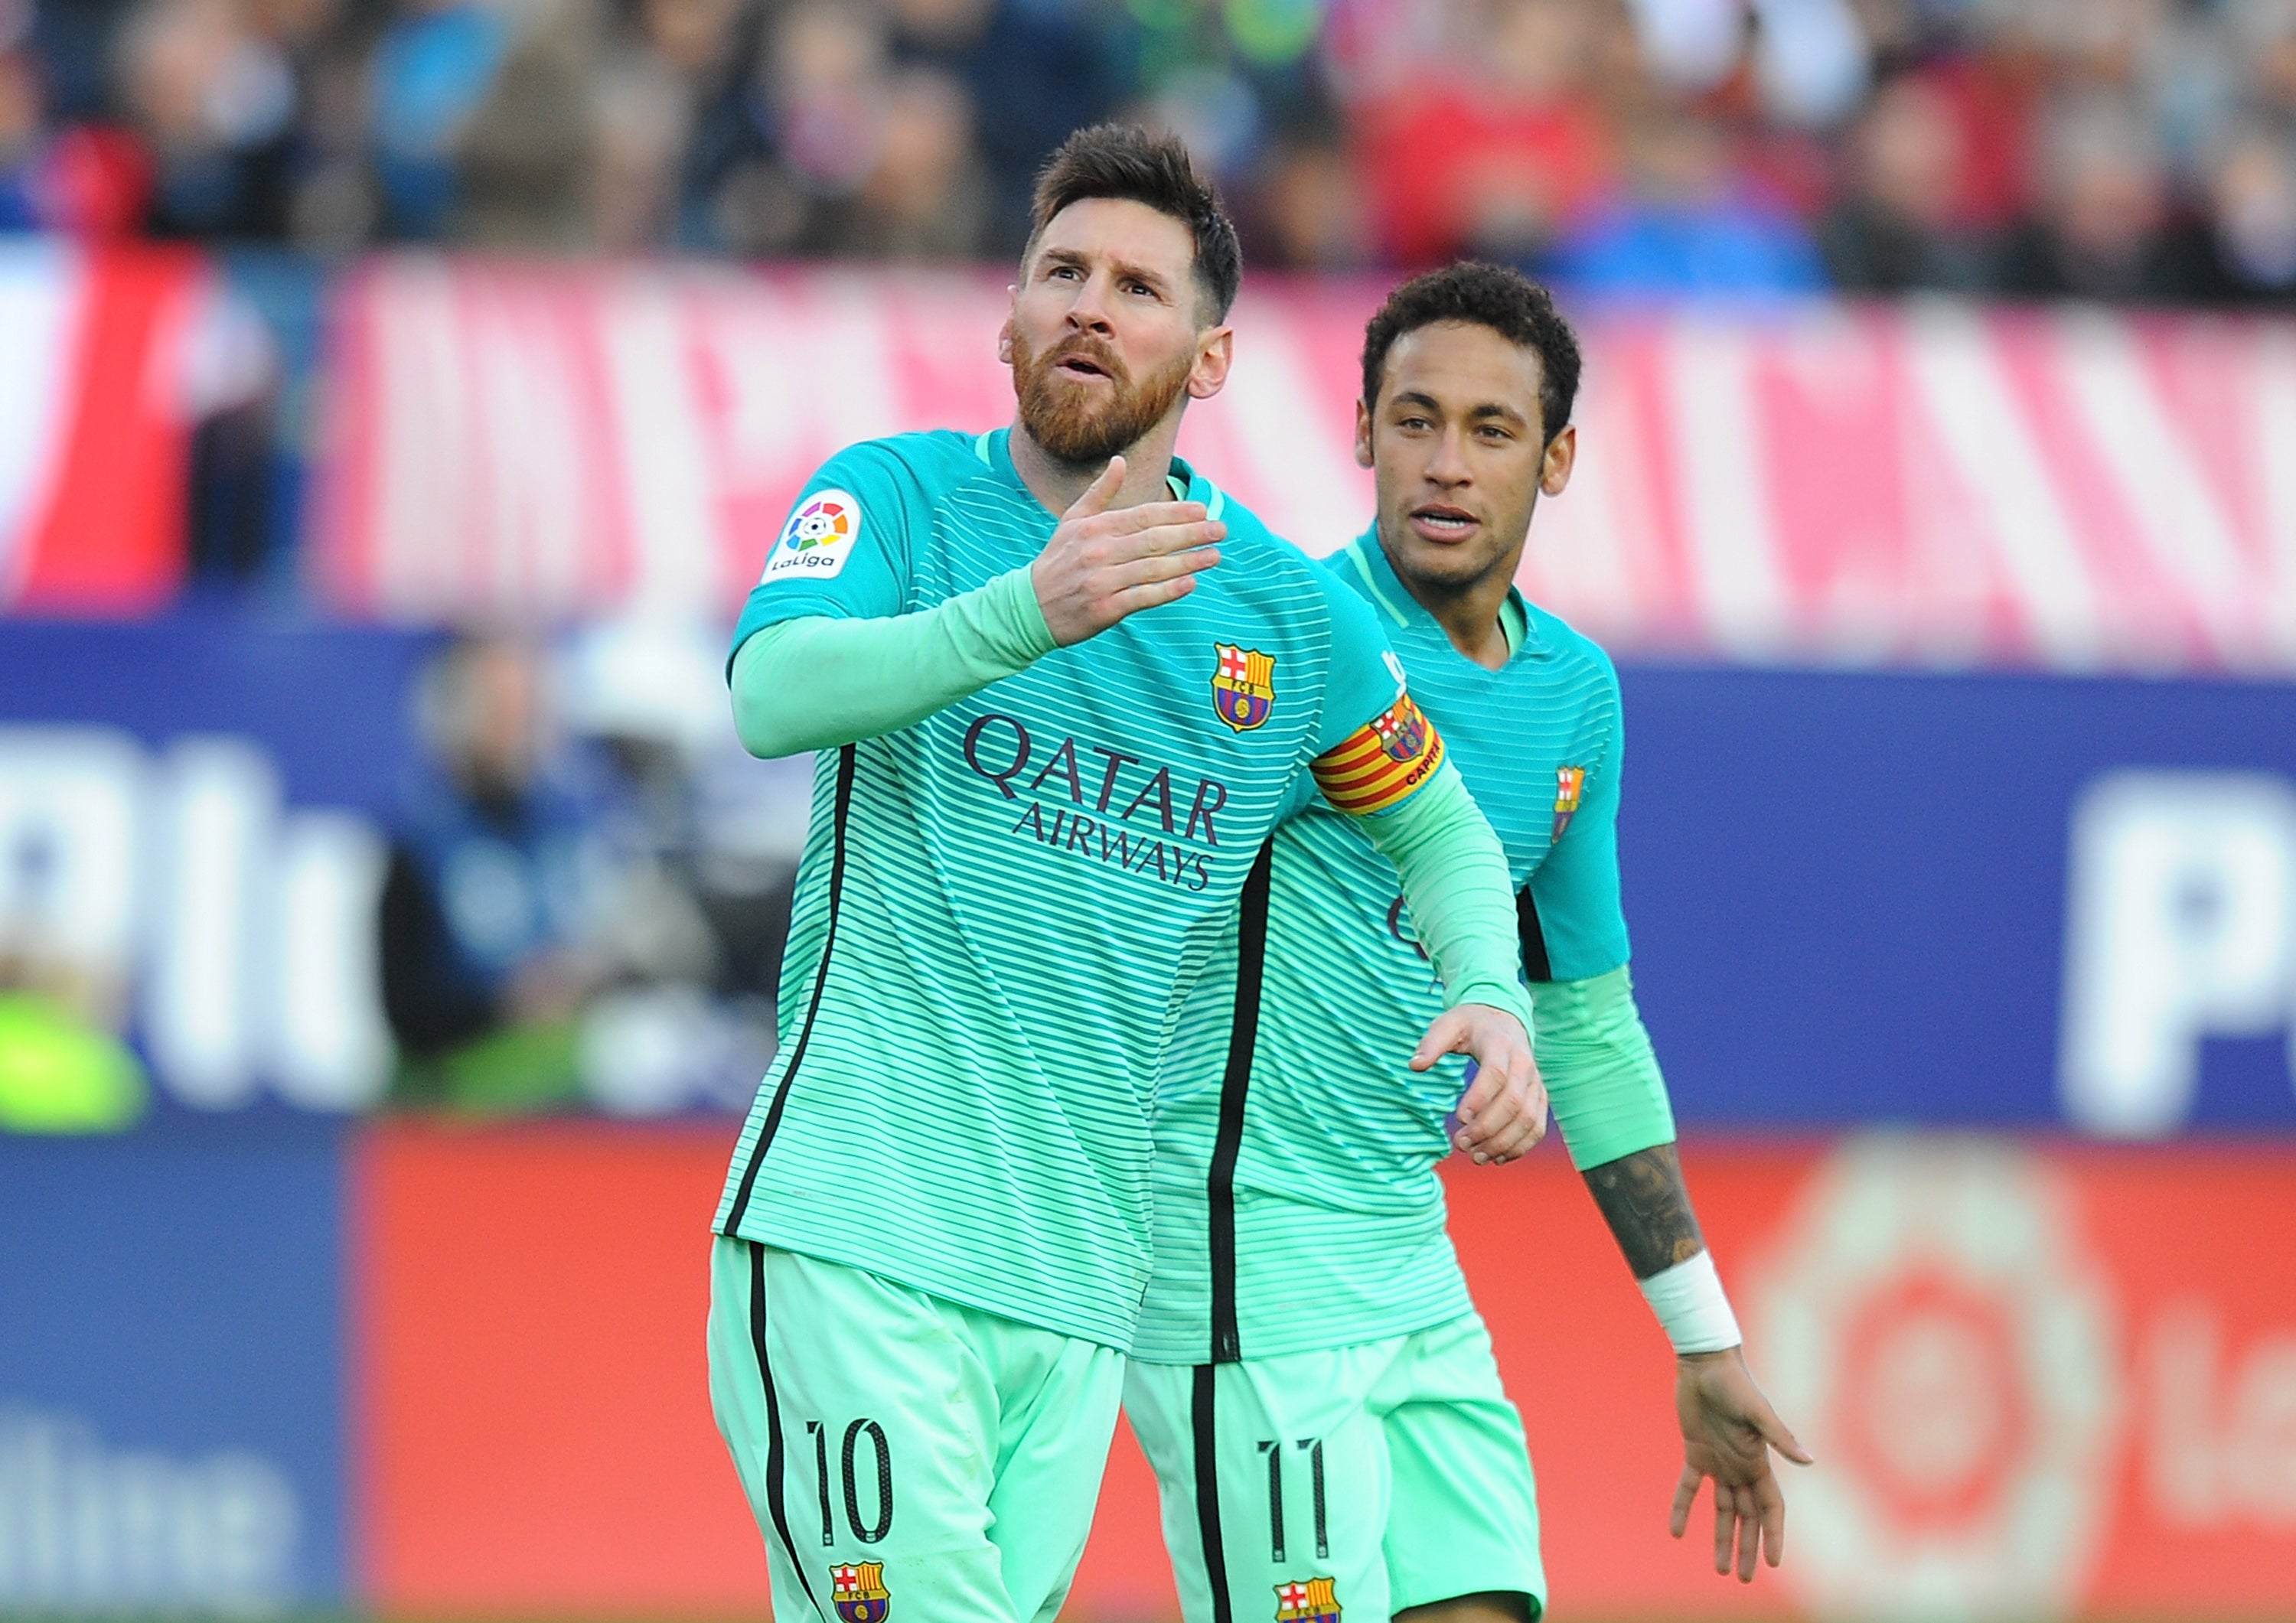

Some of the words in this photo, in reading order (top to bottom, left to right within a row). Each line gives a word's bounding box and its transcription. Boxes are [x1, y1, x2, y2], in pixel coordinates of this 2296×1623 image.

[964, 714, 1227, 847] QATAR
[1012, 801, 1215, 891] AIRWAYS
[805, 1418, 894, 1547] 10
[1257, 1437, 1329, 1563] 11
[848, 1591, 871, 1600] FCB
